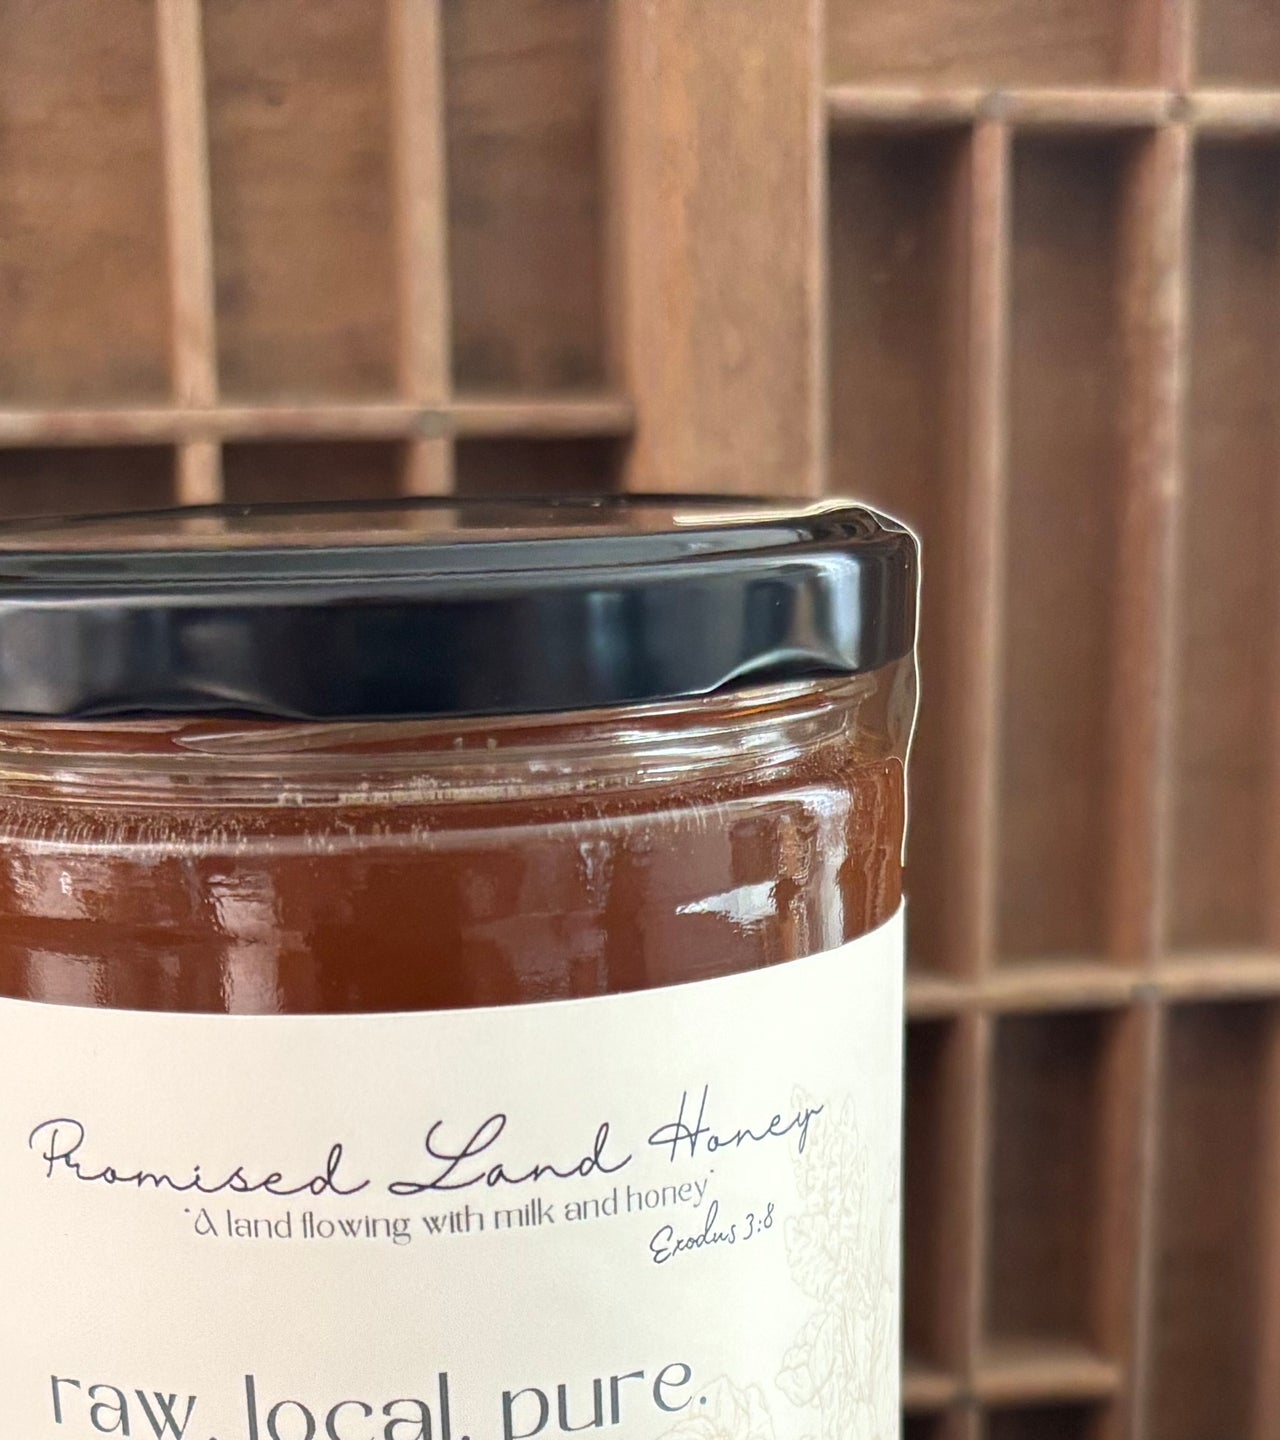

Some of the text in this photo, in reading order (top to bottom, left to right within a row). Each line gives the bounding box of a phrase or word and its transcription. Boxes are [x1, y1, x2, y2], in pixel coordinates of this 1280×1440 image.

[28, 1084, 826, 1196] Promised Land Honey
[227, 1209, 292, 1238] land
[303, 1211, 412, 1246] flowing
[422, 1204, 485, 1235] with
[494, 1198, 556, 1229] milk
[564, 1187, 618, 1221] and
[649, 1199, 776, 1264] Exodus 3:8
